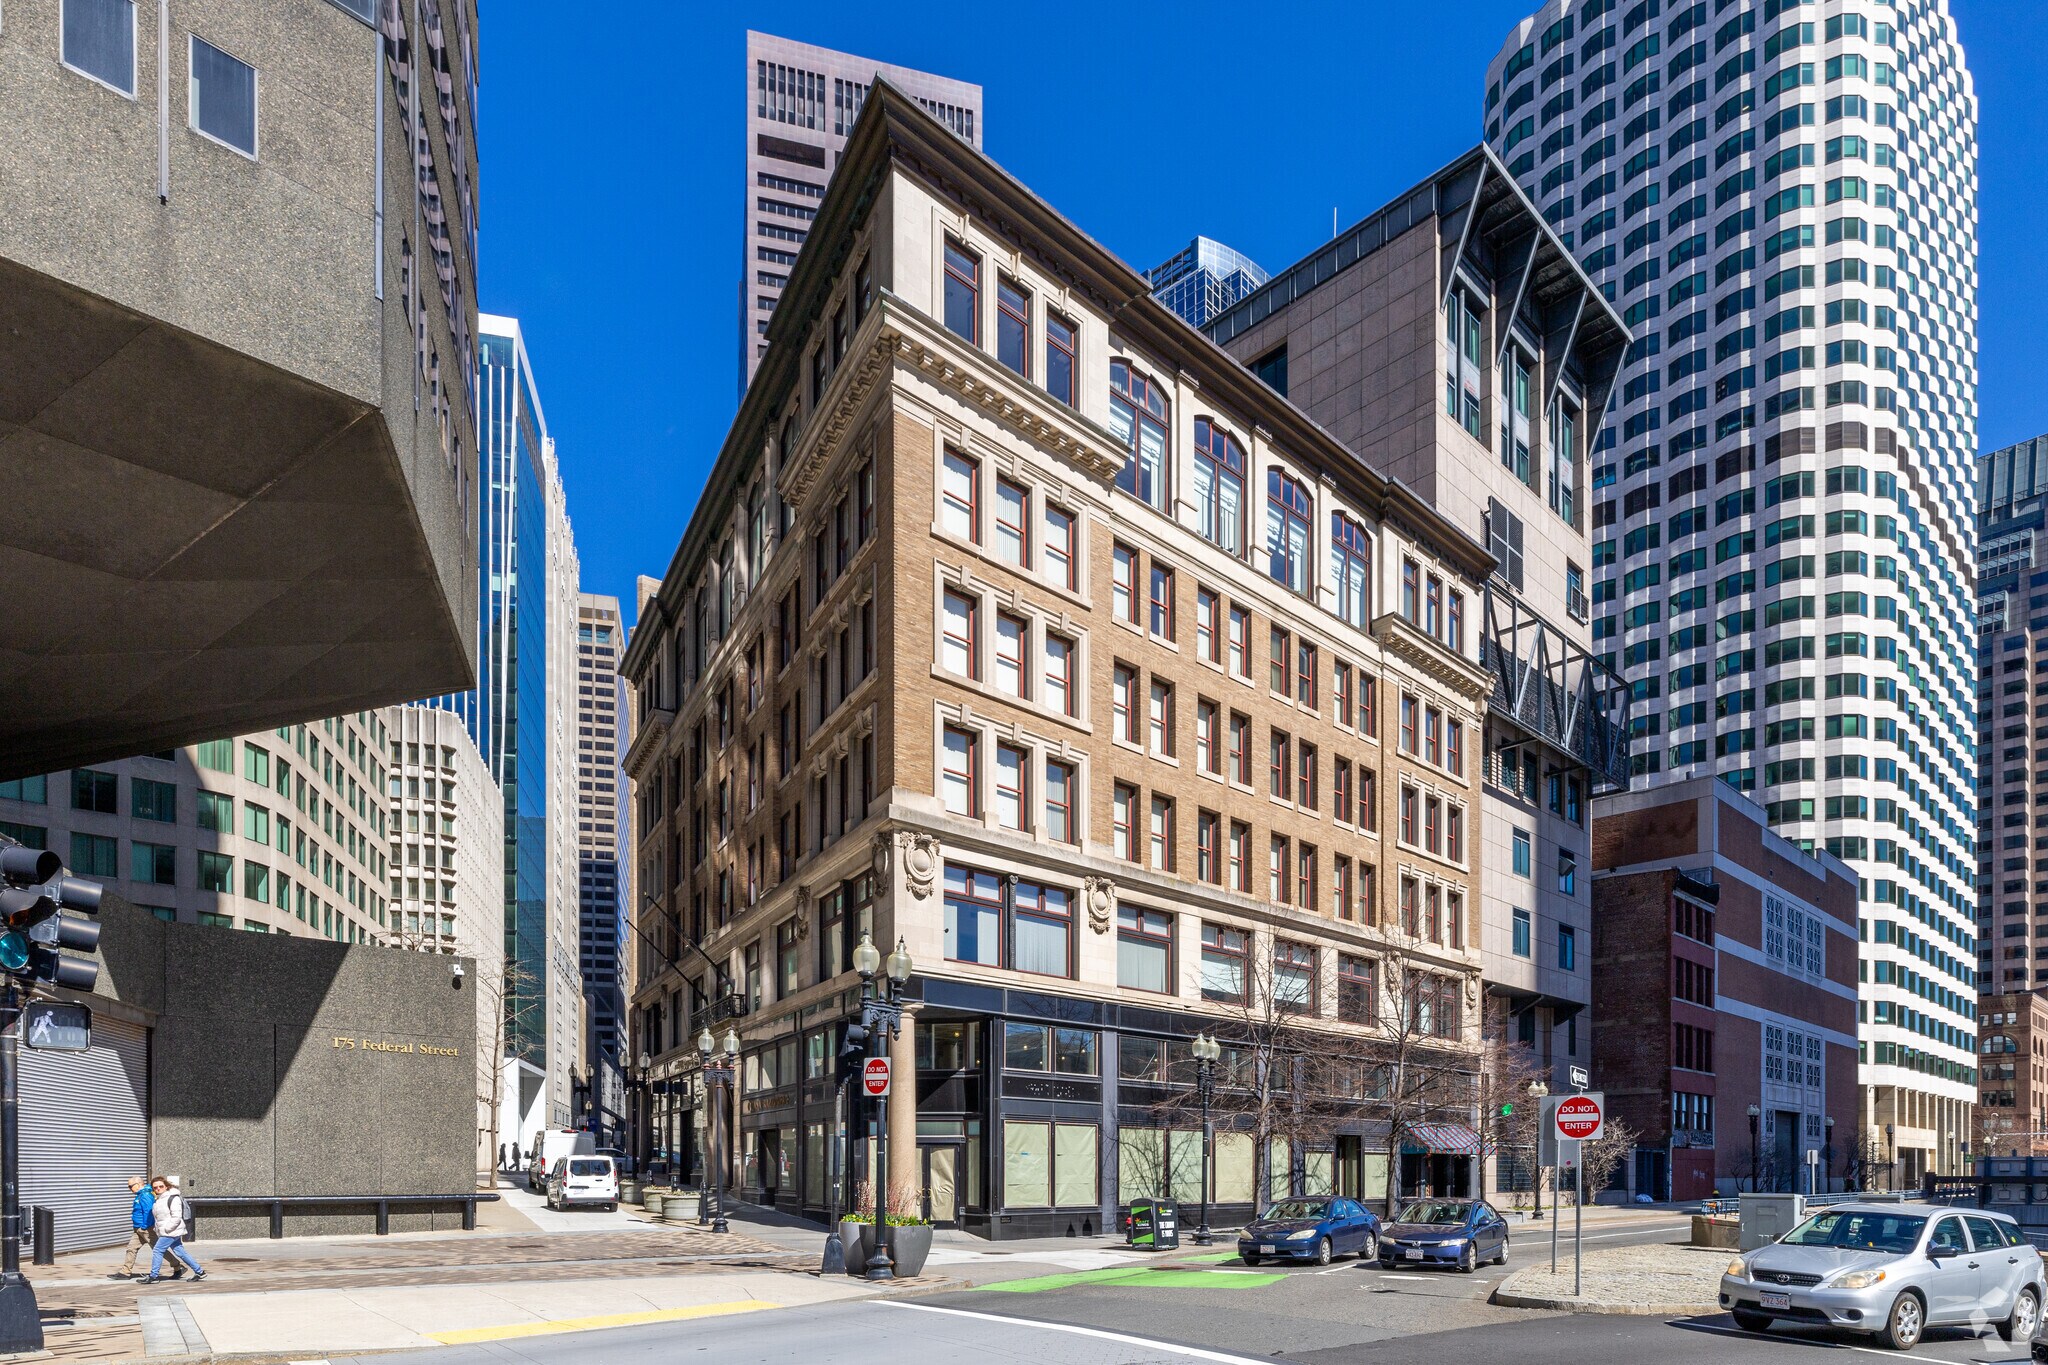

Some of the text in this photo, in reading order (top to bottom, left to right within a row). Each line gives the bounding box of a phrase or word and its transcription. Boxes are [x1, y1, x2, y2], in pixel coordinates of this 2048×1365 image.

[333, 1037, 459, 1056] 175 Federal Street
[1564, 1122, 1592, 1130] ENTER
